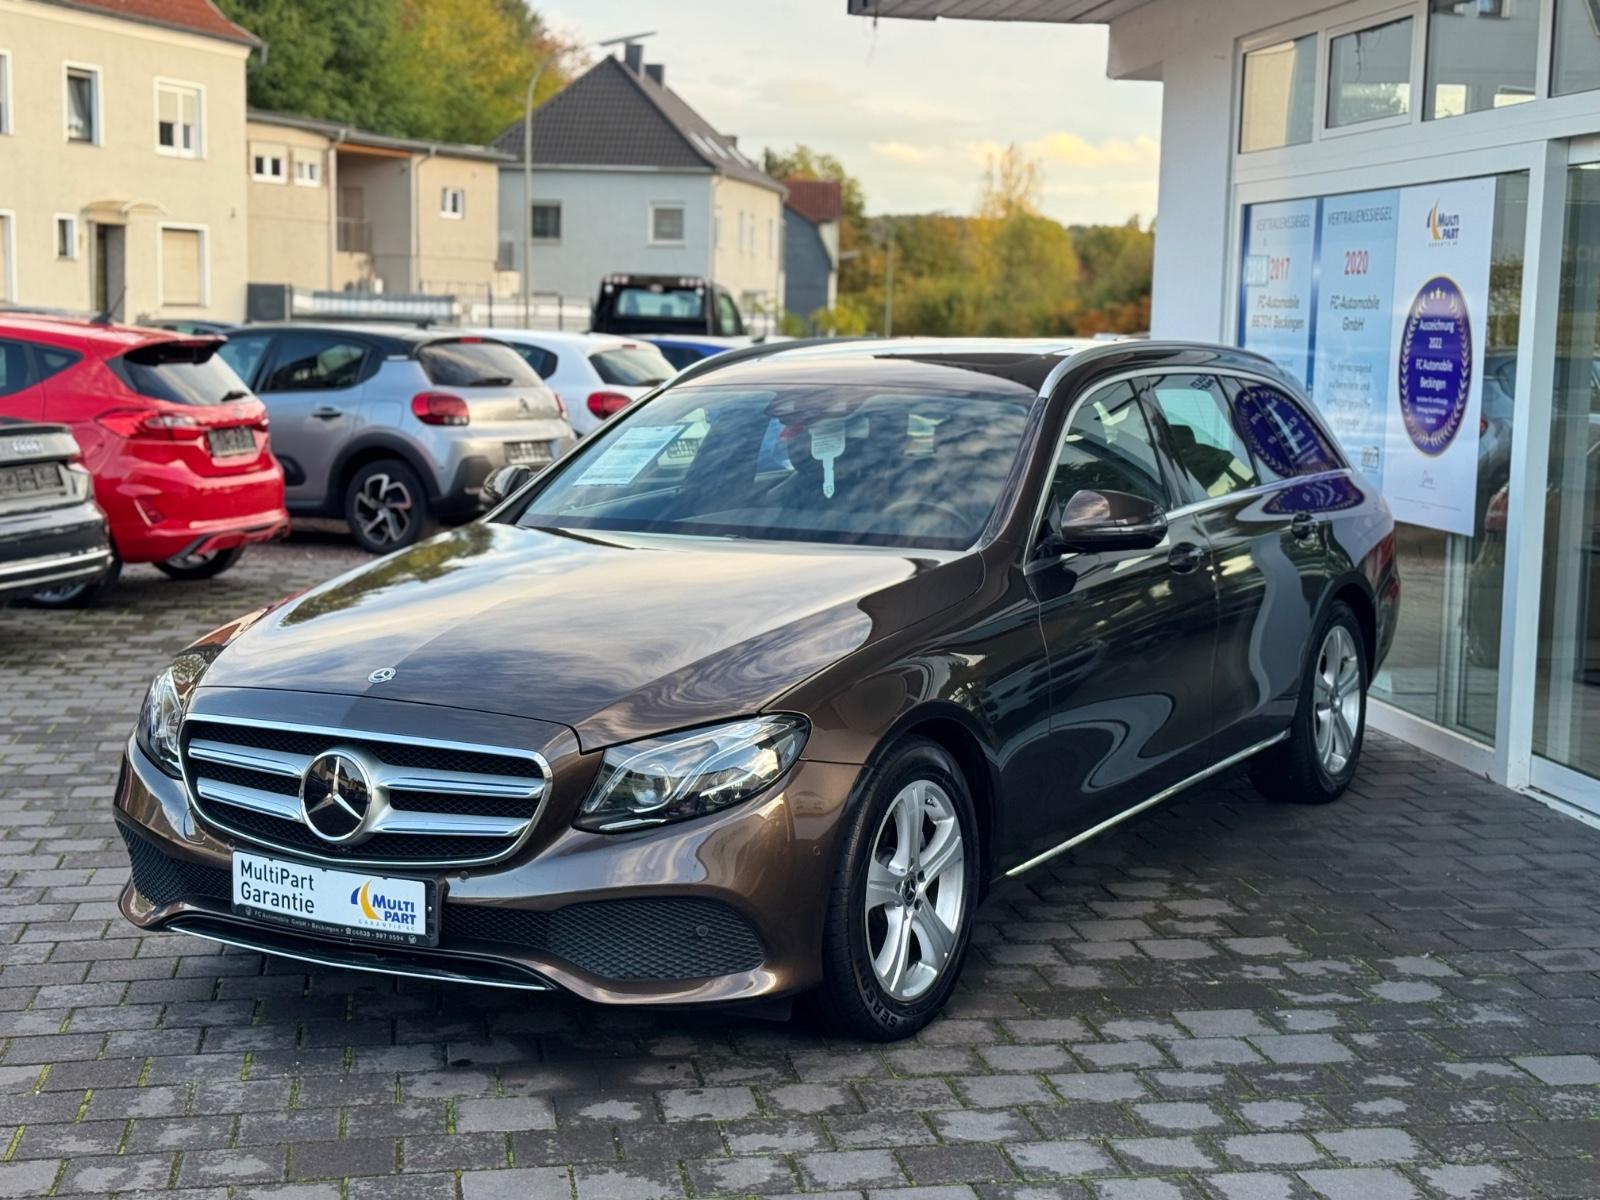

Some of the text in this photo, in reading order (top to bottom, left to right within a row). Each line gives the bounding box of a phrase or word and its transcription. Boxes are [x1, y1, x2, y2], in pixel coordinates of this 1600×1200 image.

[1327, 206, 1392, 226] VERTRAUENSSIEGEL
[1438, 212, 1460, 227] MULTI
[1442, 227, 1460, 240] PART
[1269, 257, 1291, 280] 2017
[1344, 250, 1369, 275] 2020
[1342, 317, 1365, 332] GmbH
[1418, 319, 1455, 334] Auszeichnung
[1423, 359, 1454, 372] Automobile
[1419, 376, 1447, 391] Beckingen
[241, 859, 315, 891] MultiPart
[241, 881, 315, 914] Garantie
[372, 894, 415, 912] MULTI
[385, 910, 416, 925] PART
